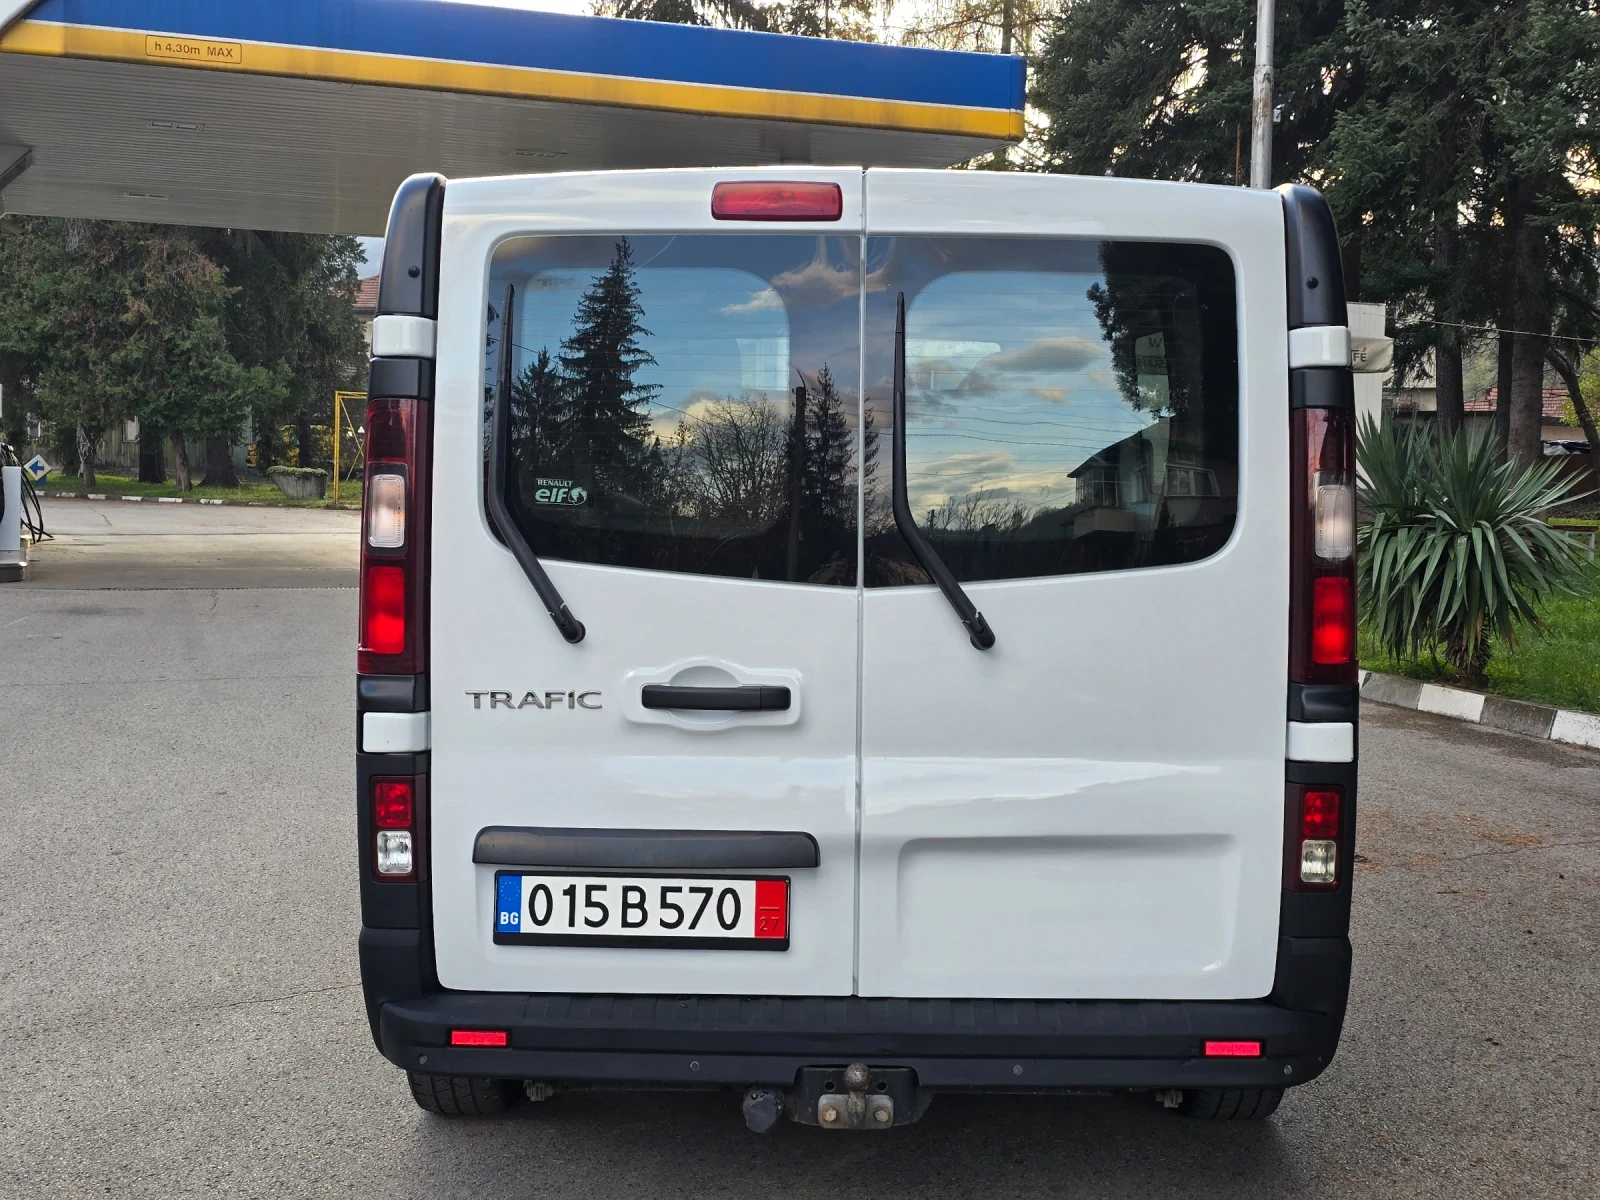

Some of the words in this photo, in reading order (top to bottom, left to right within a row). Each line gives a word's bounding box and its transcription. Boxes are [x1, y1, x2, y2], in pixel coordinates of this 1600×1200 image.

[155, 42, 162, 51] h
[165, 43, 200, 55] 4.30m
[207, 46, 233, 58] MAX
[537, 479, 573, 487] RENAULT
[535, 488, 568, 502] elf
[465, 689, 603, 710] TRAFIC
[500, 911, 519, 925] BG
[759, 916, 780, 932] 27
